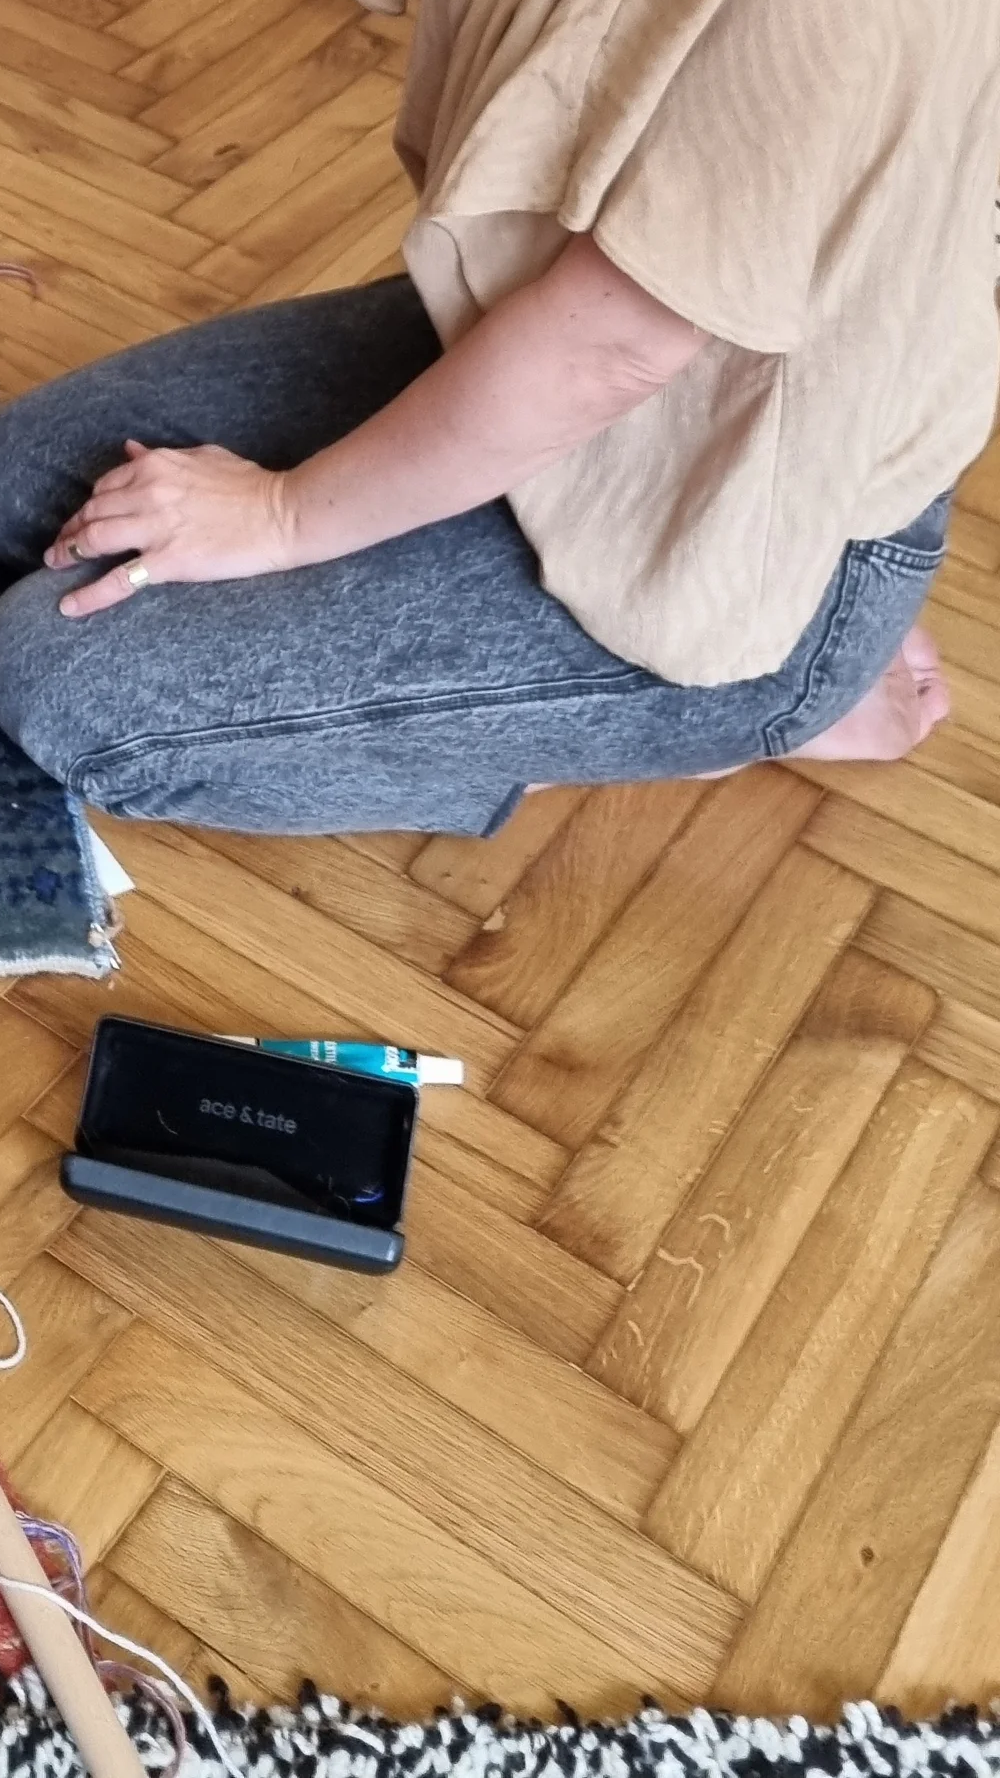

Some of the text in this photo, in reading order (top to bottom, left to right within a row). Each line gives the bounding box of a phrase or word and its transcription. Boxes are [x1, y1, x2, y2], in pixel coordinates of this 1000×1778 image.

[199, 1098, 297, 1135] ace & tate
